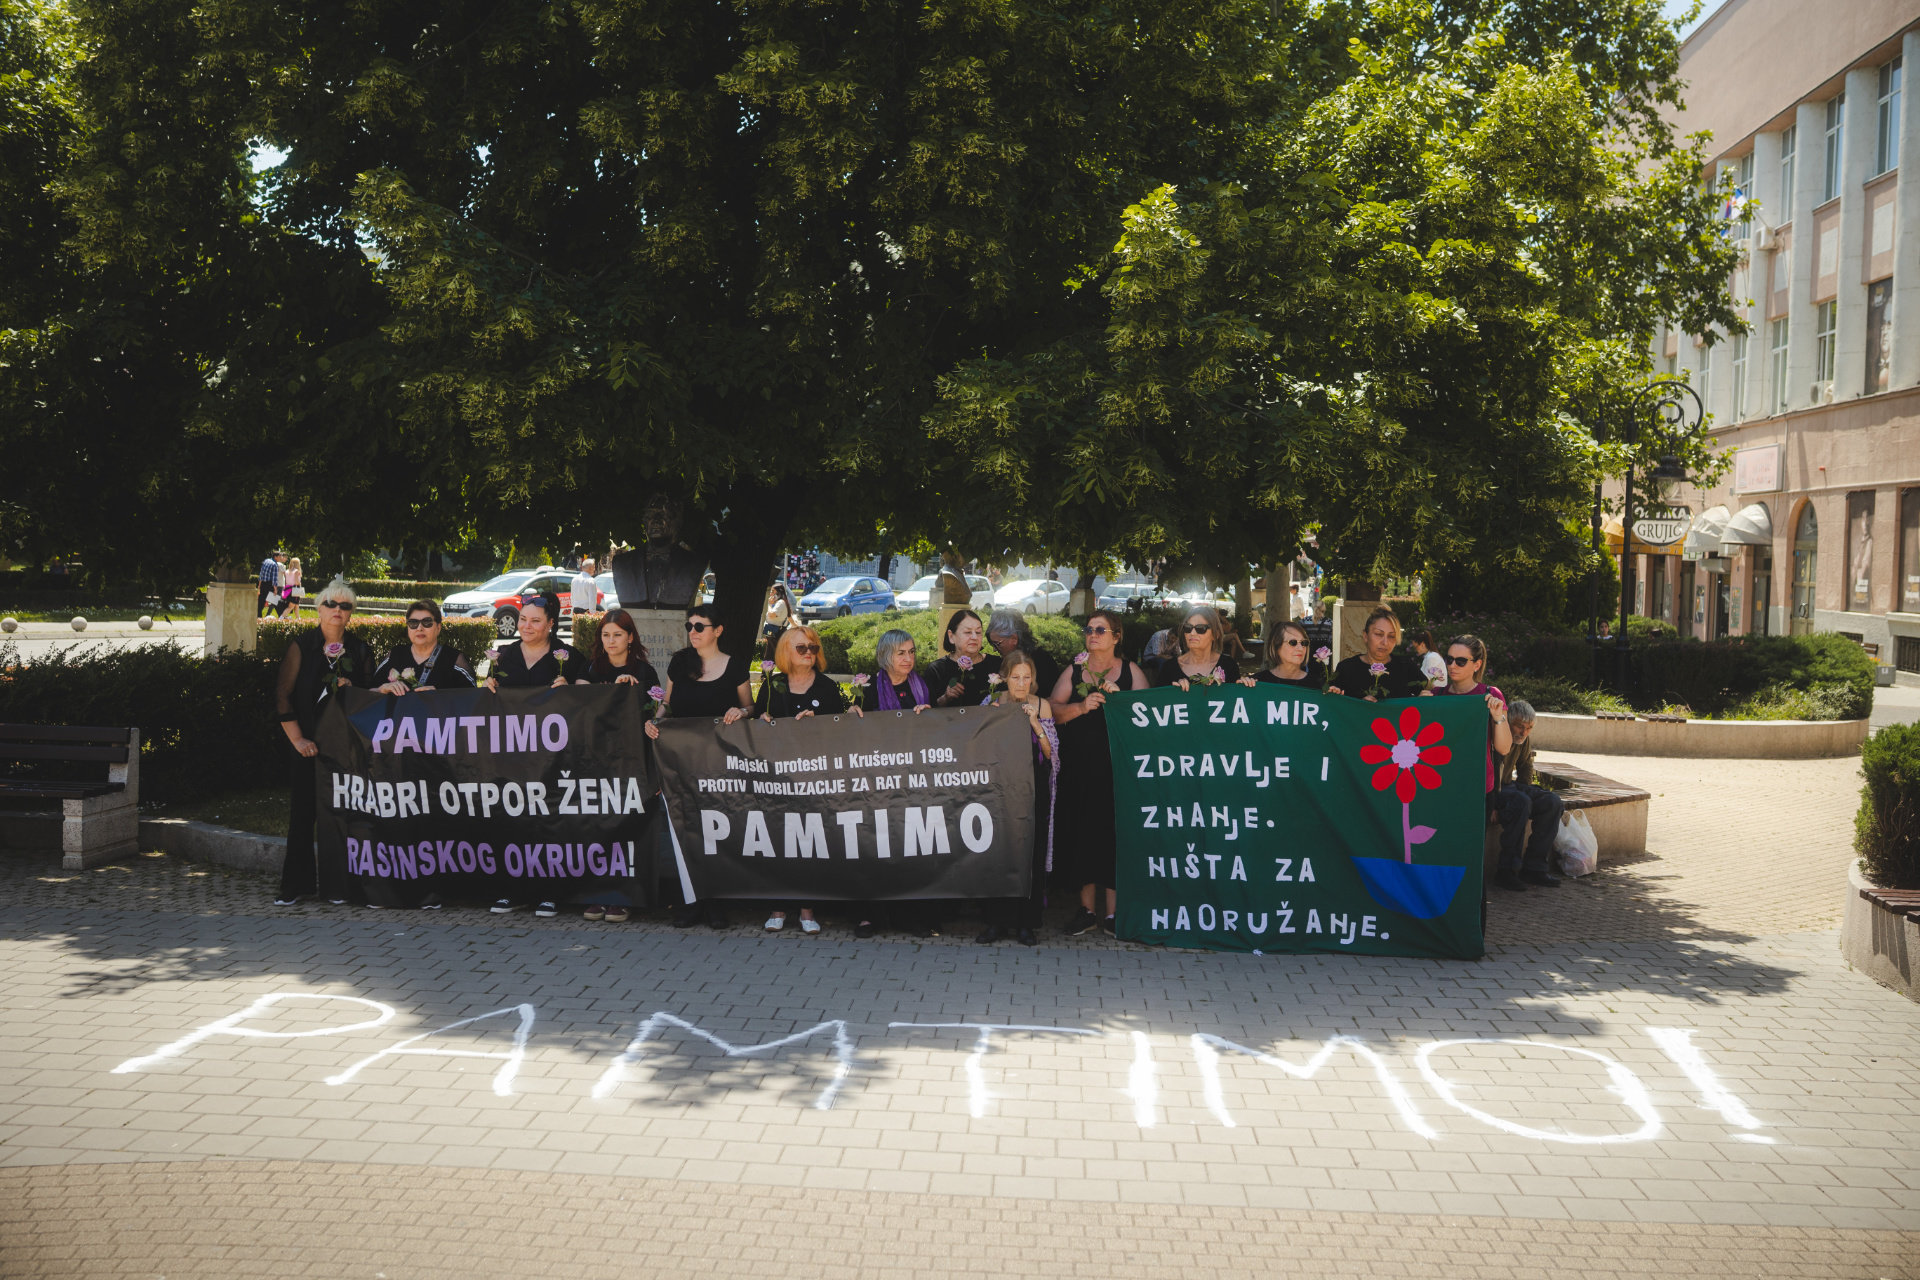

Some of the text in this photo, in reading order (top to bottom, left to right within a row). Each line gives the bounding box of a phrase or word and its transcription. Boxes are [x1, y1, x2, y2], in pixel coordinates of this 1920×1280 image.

[1637, 522, 1682, 543] GRUJIĆ
[372, 713, 569, 755] PAMTIMO
[1131, 697, 1329, 732] SVE ZA MIR,
[726, 747, 957, 776] Majski protesti u Kruševcu 1999.
[1134, 751, 1329, 788] ZDRAVLJE I
[332, 770, 645, 818] HRABRI OTPOR ŽENA
[698, 770, 989, 796] PROTIV MOBILIZACIJE ZA RAT NA KOSOVU
[700, 802, 994, 860] PAMTIMO
[1141, 802, 1275, 841] ZNANJE.
[347, 837, 636, 880] RASINSKOG OKRUGA!
[1148, 843, 1316, 882] NIŠTA ZA
[1151, 901, 1390, 945] NAORUŽANJE.
[110, 992, 1777, 1147] PAMTIMO!
